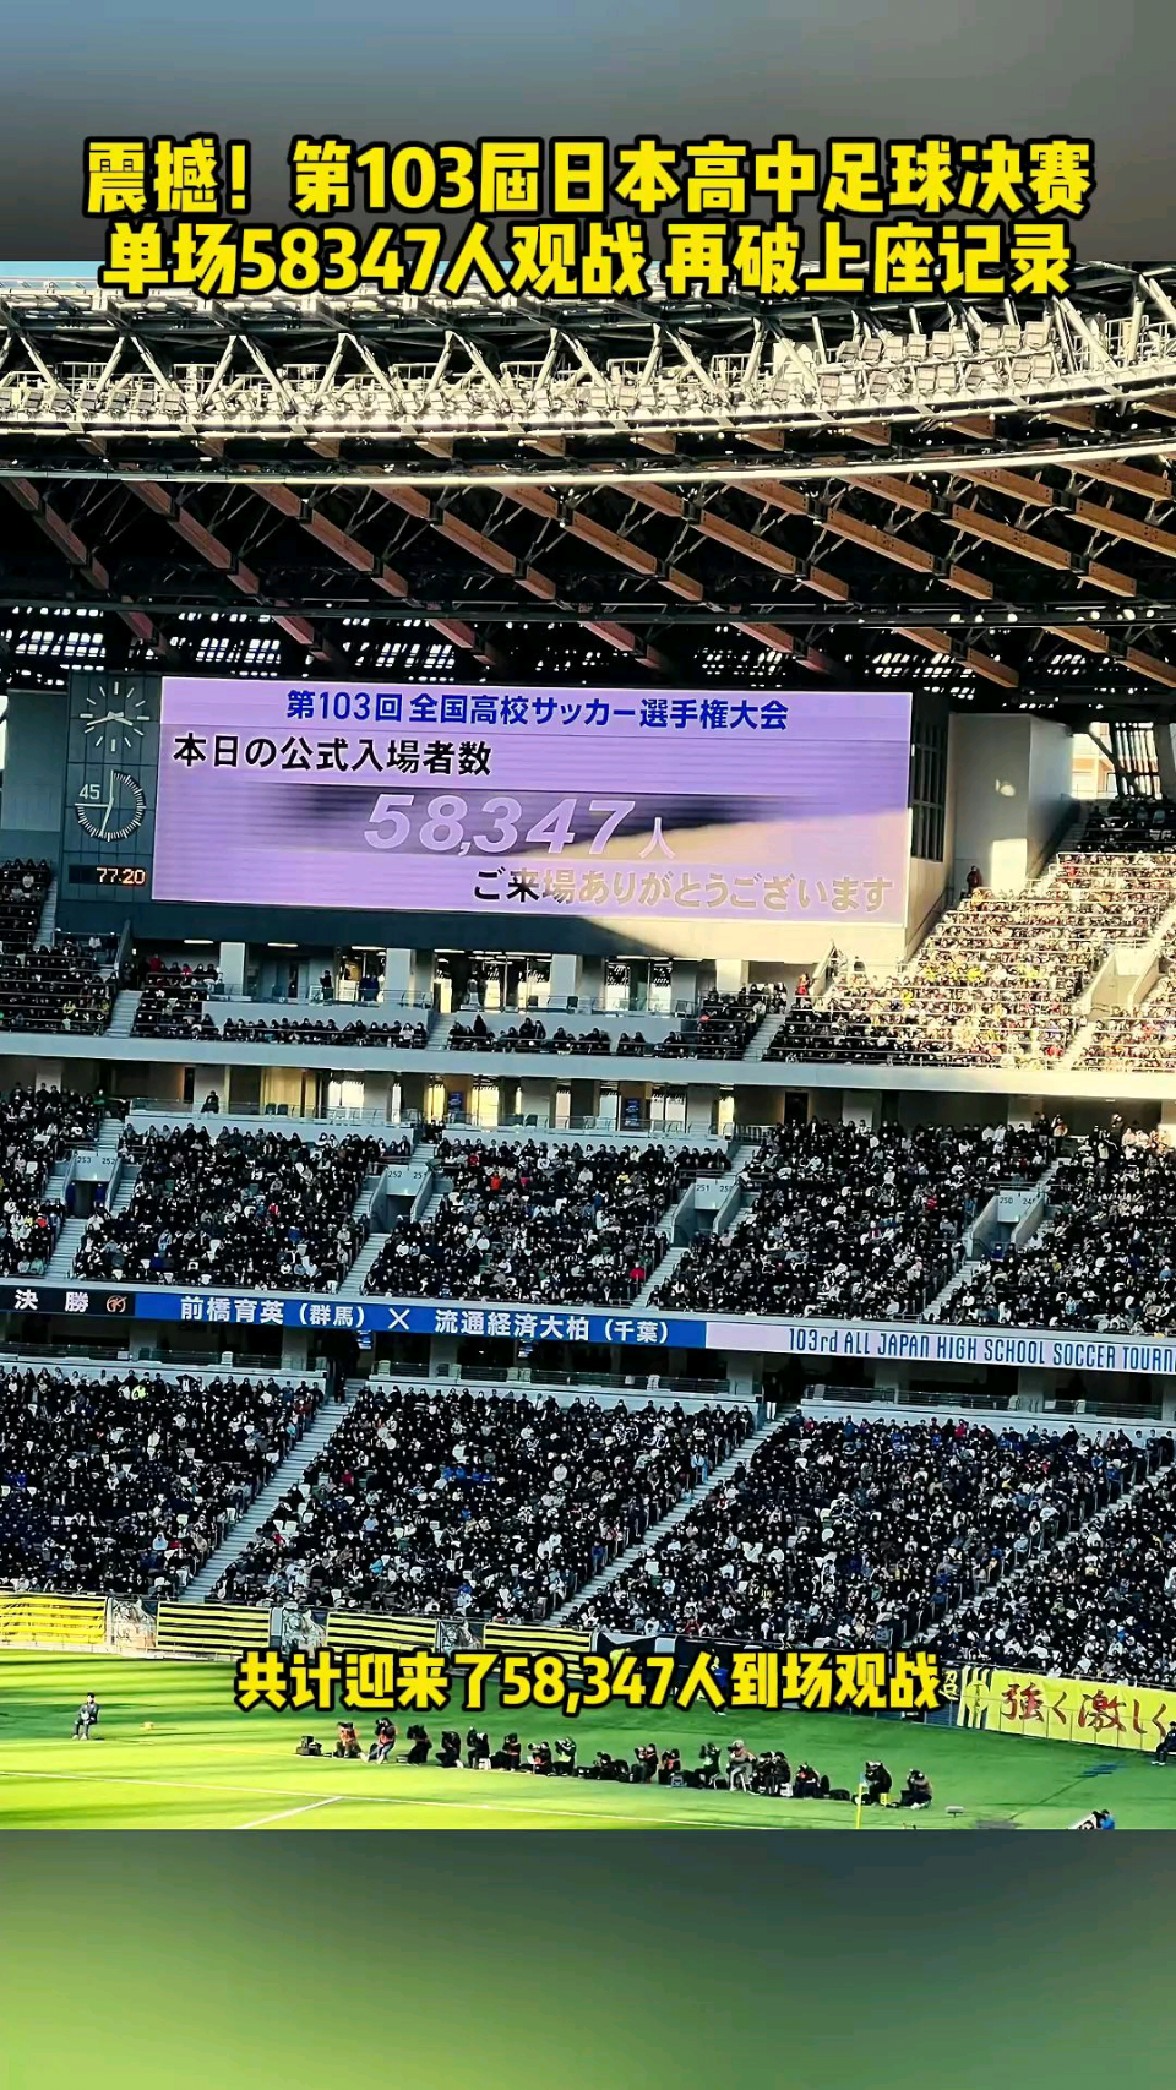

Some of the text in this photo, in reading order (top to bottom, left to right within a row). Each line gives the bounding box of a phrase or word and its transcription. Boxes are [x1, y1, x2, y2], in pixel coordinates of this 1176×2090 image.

[173, 732, 492, 776] 本日の公式入場者数
[79, 783, 101, 800] 45
[473, 866, 894, 912] ご来場ありがとうございます
[788, 1327, 1176, 1372] 103rd ALL JAPAN HIGH SCHOOL SOCCER TOURN
